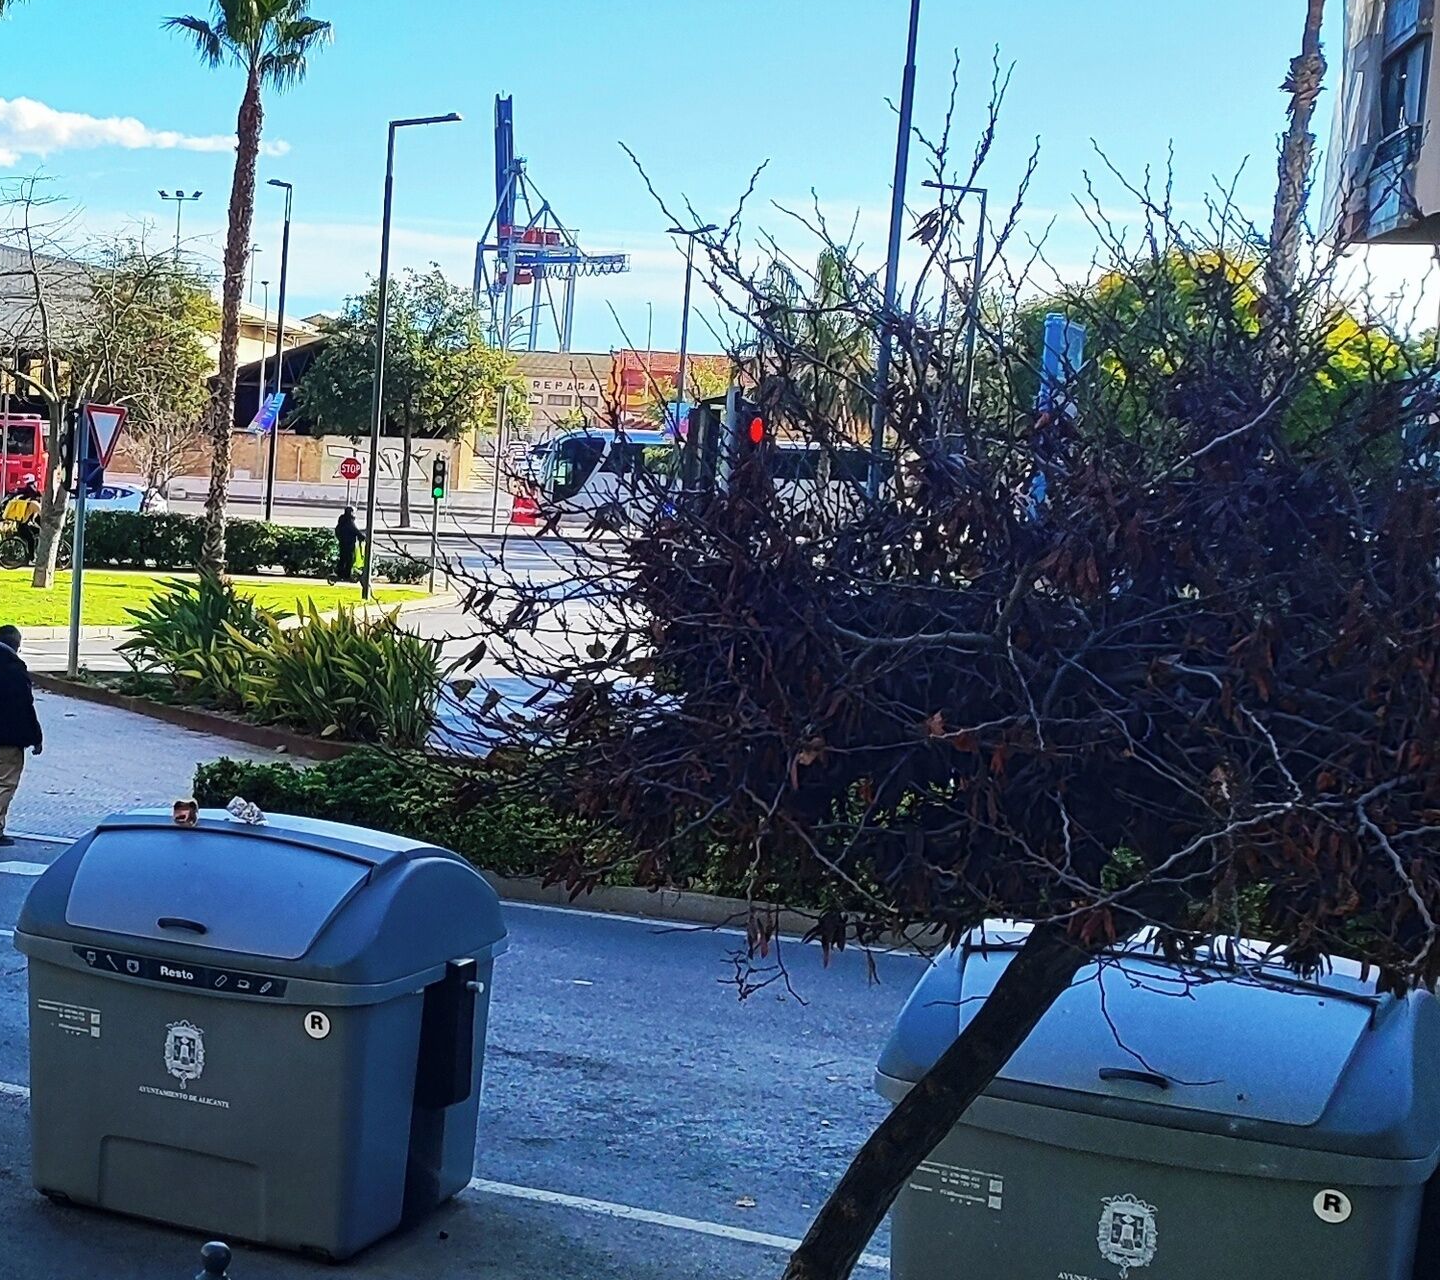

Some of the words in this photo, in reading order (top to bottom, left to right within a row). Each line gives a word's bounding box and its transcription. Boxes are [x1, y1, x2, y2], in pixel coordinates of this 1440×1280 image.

[341, 464, 361, 474] STOP
[160, 965, 194, 980] Resto
[310, 1014, 323, 1030] R
[139, 1085, 188, 1100] AYUNTAMIENTO
[188, 1093, 198, 1102] DE
[198, 1096, 230, 1109] ALICANTE
[1323, 1192, 1341, 1213] R
